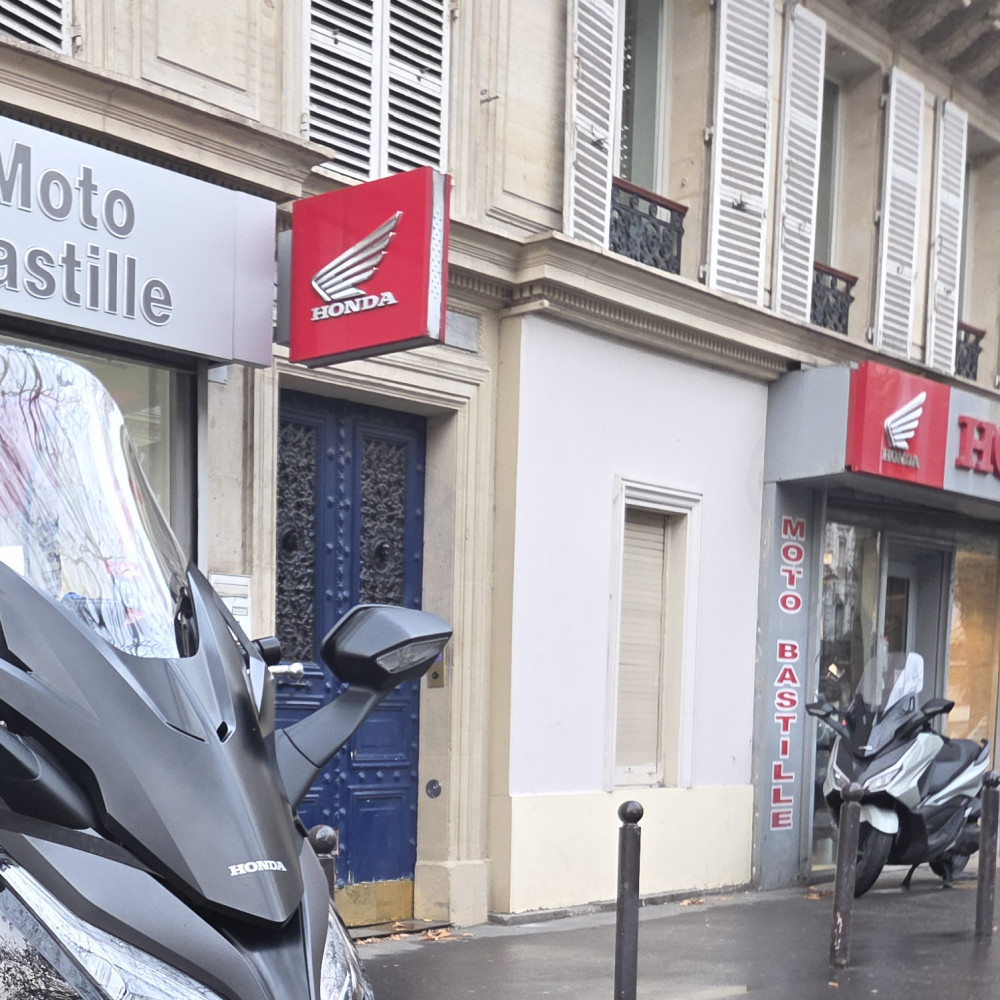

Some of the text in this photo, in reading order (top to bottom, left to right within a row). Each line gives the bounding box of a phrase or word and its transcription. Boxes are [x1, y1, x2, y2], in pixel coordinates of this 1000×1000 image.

[310, 292, 399, 321] HONDA
[882, 449, 920, 469] HONDA
[955, 414, 1000, 481] H
[778, 516, 806, 615] MOTO
[770, 640, 800, 831] BASTILLE
[228, 860, 288, 876] HONDA
